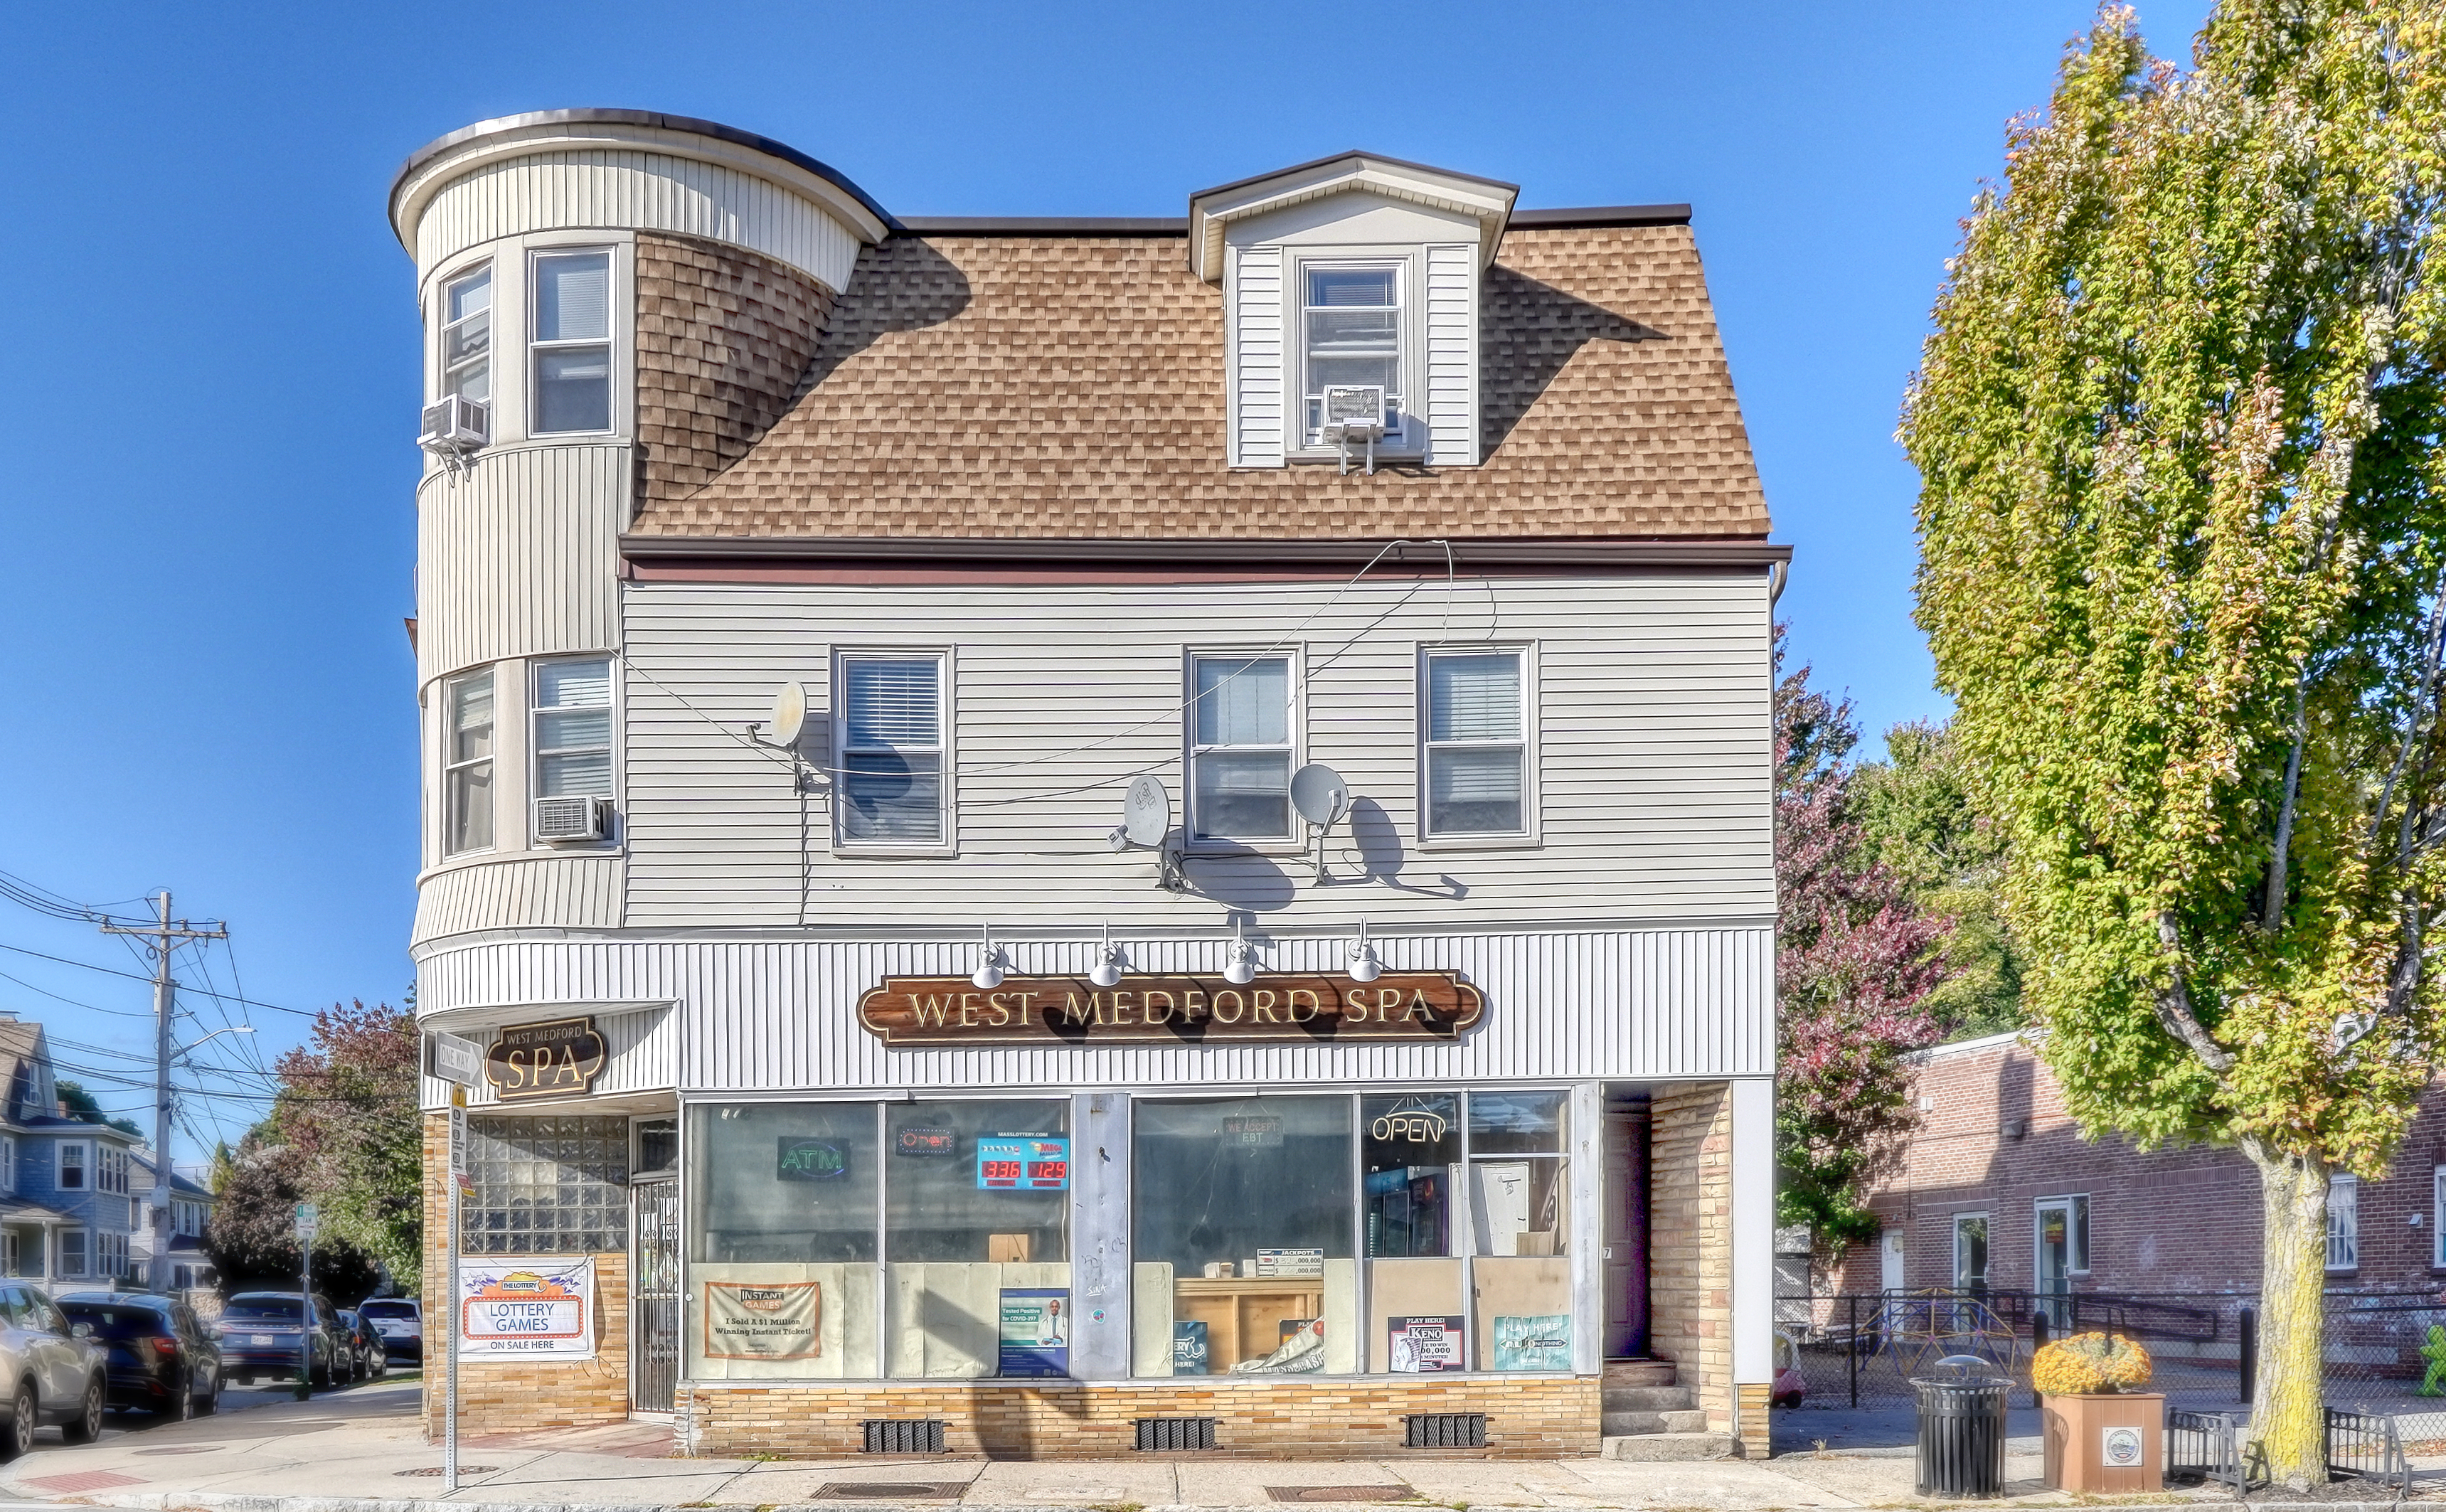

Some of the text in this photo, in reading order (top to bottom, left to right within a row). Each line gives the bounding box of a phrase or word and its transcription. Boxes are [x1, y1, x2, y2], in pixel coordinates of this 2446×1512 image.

[907, 988, 1438, 1027] WEST MEDFORD SPA
[507, 1026, 583, 1045] WEST MEDFORD
[441, 1044, 470, 1070] ONE WAY
[506, 1044, 583, 1090] SPA
[1228, 1122, 1277, 1132] WE ACCEPT
[1372, 1116, 1442, 1143] OPEN
[1242, 1132, 1263, 1142] EBT
[781, 1149, 842, 1169] ATM
[987, 1161, 1066, 1178] 336 129
[1605, 1248, 1610, 1258] 7
[742, 1290, 782, 1300] INSTANT
[490, 1303, 555, 1316] LOTTERY
[745, 1300, 780, 1309] GAMES
[496, 1318, 549, 1331] GAMES
[1504, 1322, 1563, 1333] PLAY HERE!
[715, 1328, 750, 1336] Winning
[490, 1340, 555, 1349] ON SALE HERE
